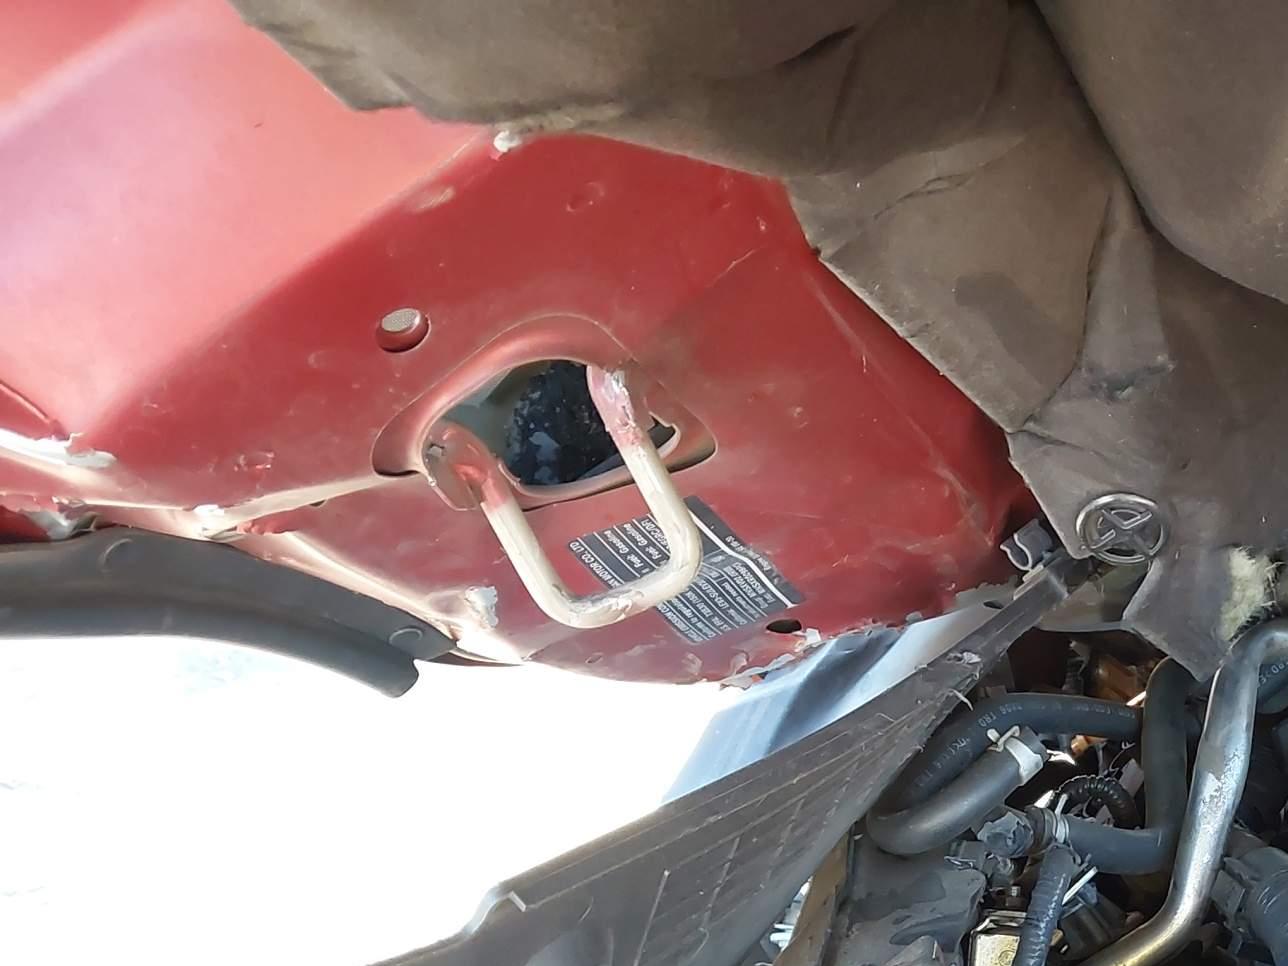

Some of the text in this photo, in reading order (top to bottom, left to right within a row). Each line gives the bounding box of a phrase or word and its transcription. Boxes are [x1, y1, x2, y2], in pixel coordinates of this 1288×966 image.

[603, 529, 629, 553] Gasoline
[622, 523, 648, 546] Gasoline
[589, 561, 613, 581] MOTOR
